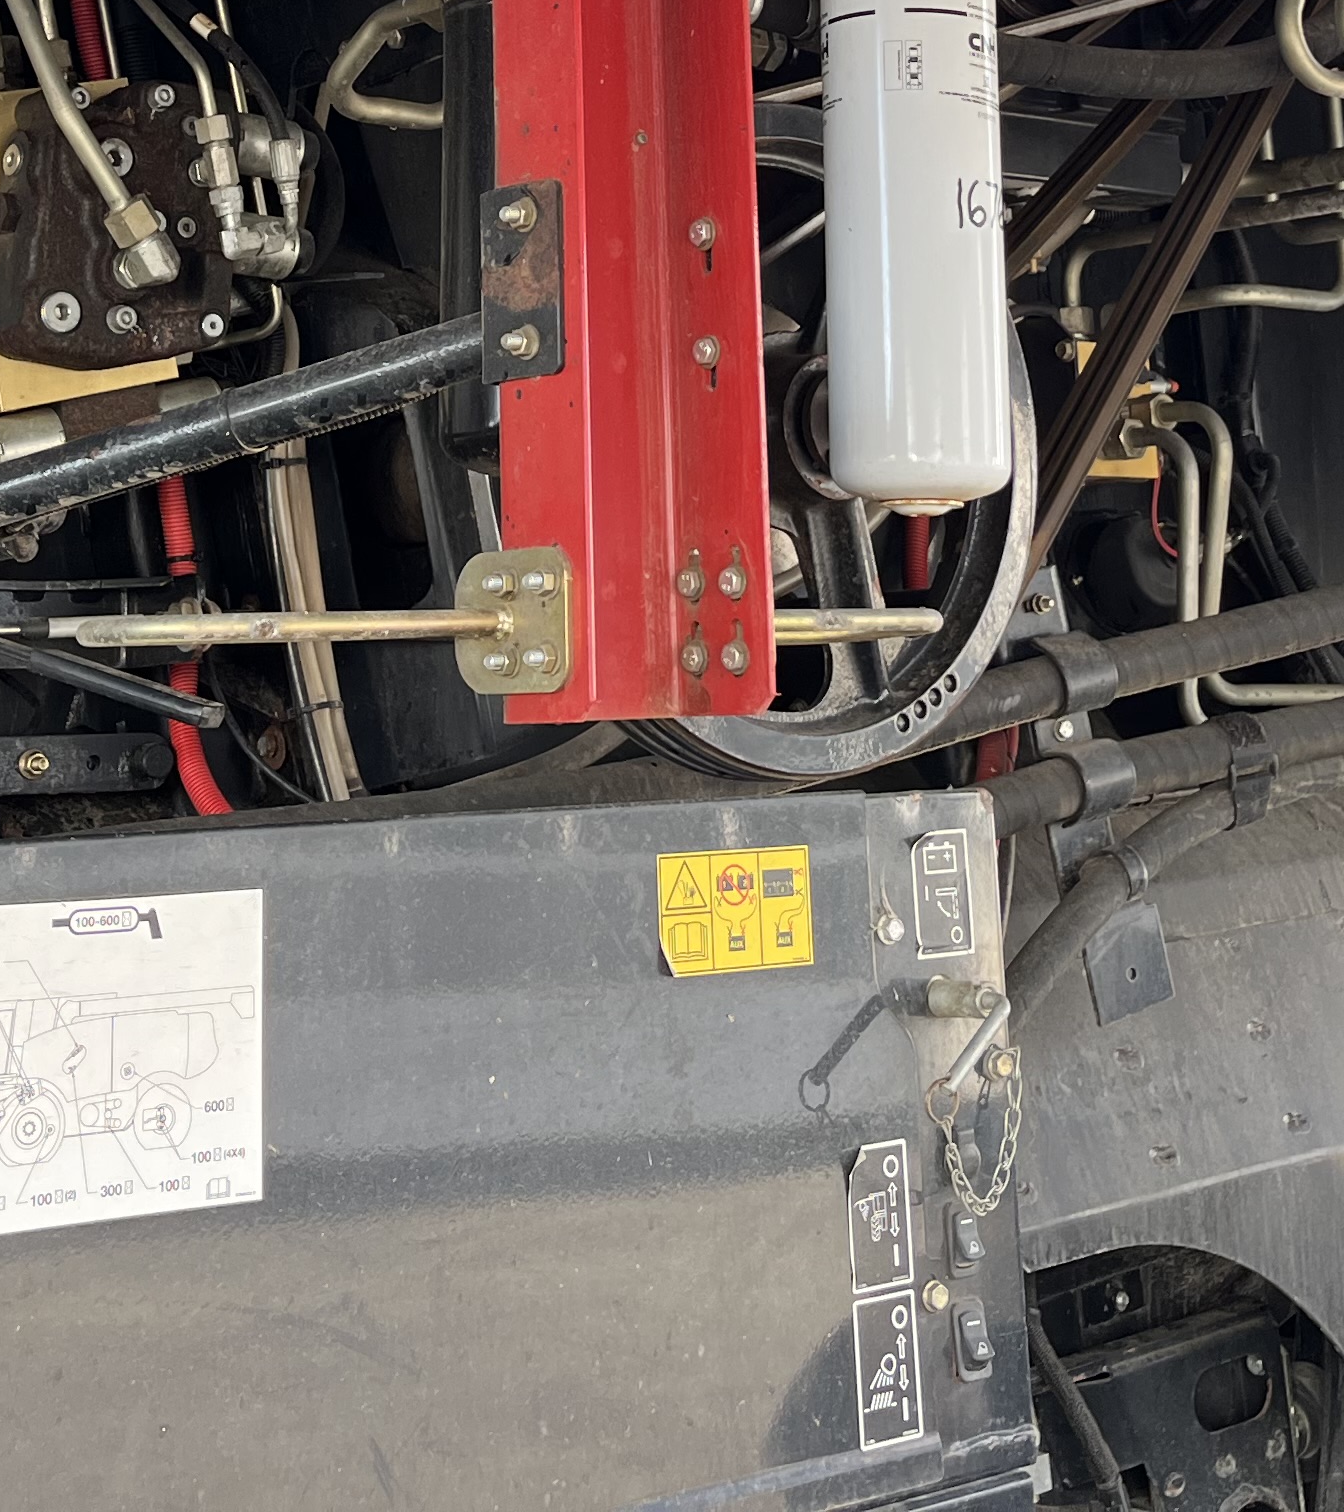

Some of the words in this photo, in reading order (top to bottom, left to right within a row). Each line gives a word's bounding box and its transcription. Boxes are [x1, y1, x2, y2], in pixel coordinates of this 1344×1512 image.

[74, 914, 120, 928] 100-600
[203, 1098, 225, 1113] 600
[190, 1150, 212, 1163] 100
[100, 1183, 123, 1197] 300
[158, 1178, 180, 1192] 100
[29, 1192, 53, 1206] 100
[64, 1189, 77, 1204] (2)
